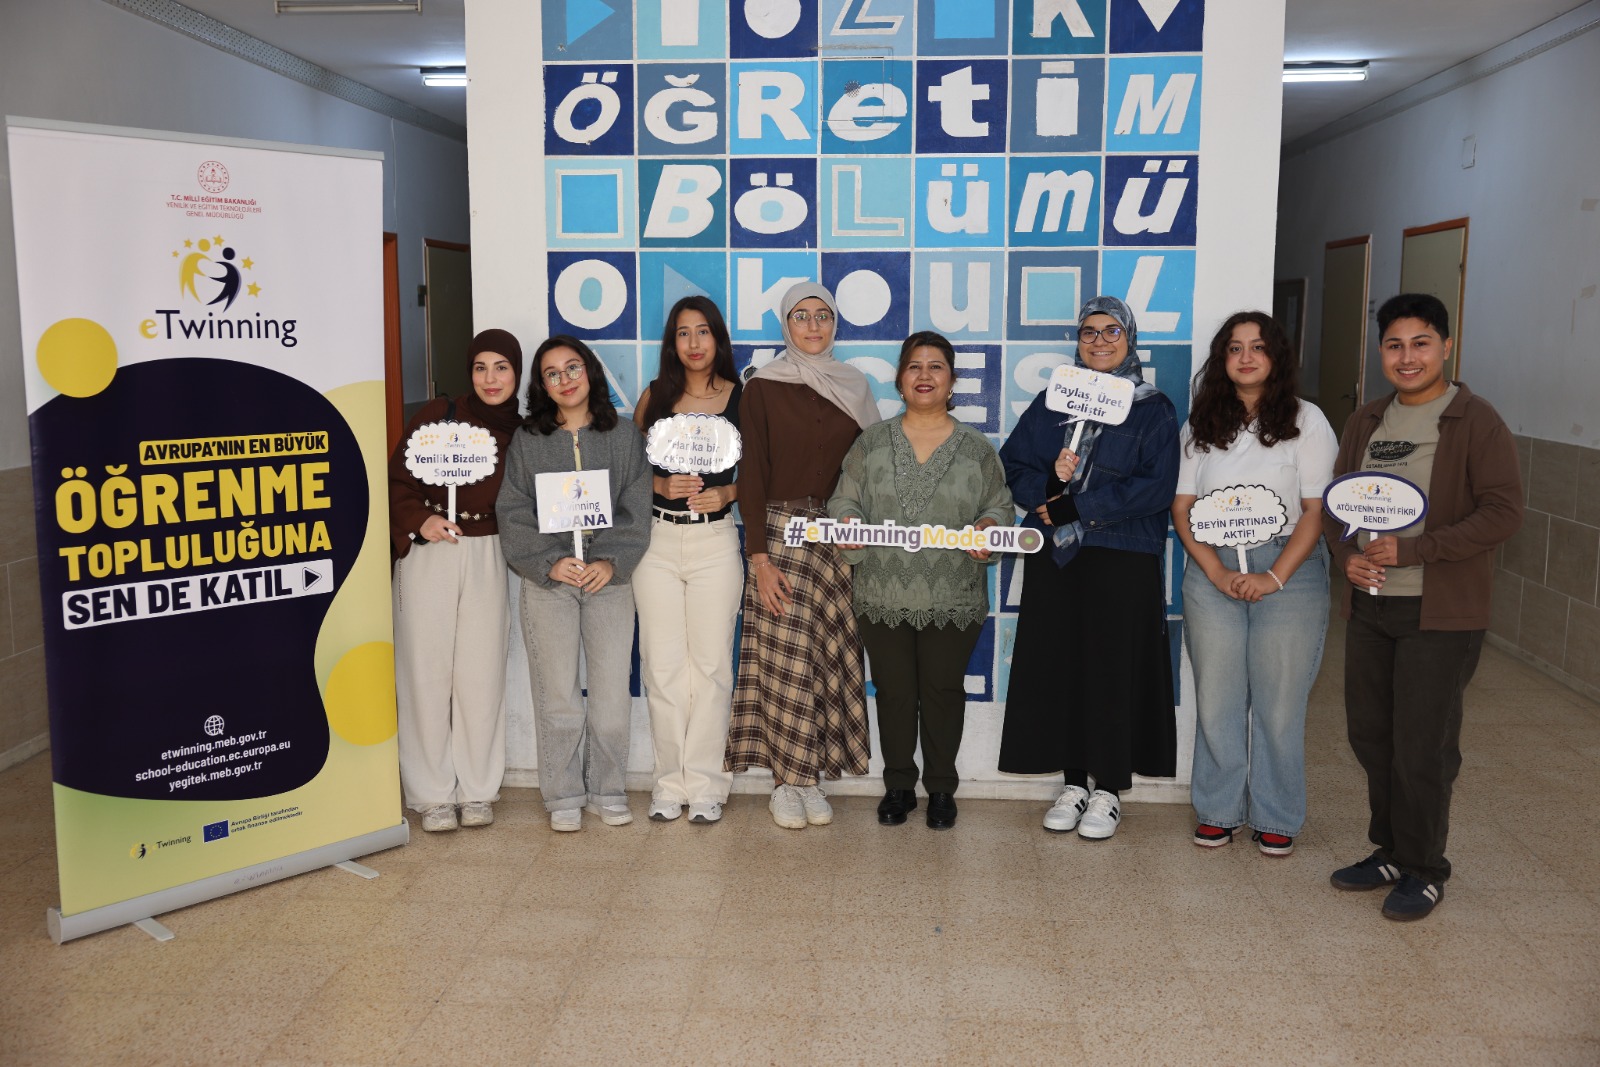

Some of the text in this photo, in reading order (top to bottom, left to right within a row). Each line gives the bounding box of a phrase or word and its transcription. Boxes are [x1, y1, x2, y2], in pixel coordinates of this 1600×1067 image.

[224, 197, 256, 205] BAKANLIĞI
[206, 211, 244, 219] MÜDÜRLÜĞÜ
[139, 309, 298, 347] eTwinning
[1066, 401, 1107, 417] Geliştir
[1097, 392, 1125, 410] Üret,
[143, 432, 326, 461] AVRUPA'NIN EN BÜYÜK
[667, 439, 721, 453] "Harka bir
[414, 454, 488, 464] Yenilik Bizden
[434, 467, 472, 477] Sorulur
[55, 461, 331, 534] ÖĞRENME
[1336, 503, 1416, 517] ATÖLYENİN EN İYİ FİKRİ
[1197, 516, 1277, 530] BEYİN FIRTINASI
[1363, 515, 1390, 524] BENDE!
[1223, 529, 1255, 540] AKTİF!
[58, 520, 333, 582] TOPLULUĞUNA
[67, 569, 293, 626] SEN DE KATIL
[160, 729, 267, 761] etwinning.meb.gov.tr
[135, 739, 291, 782] school-education.ec.europa.eu
[168, 760, 263, 792] yegitek.meb.gov.tr
